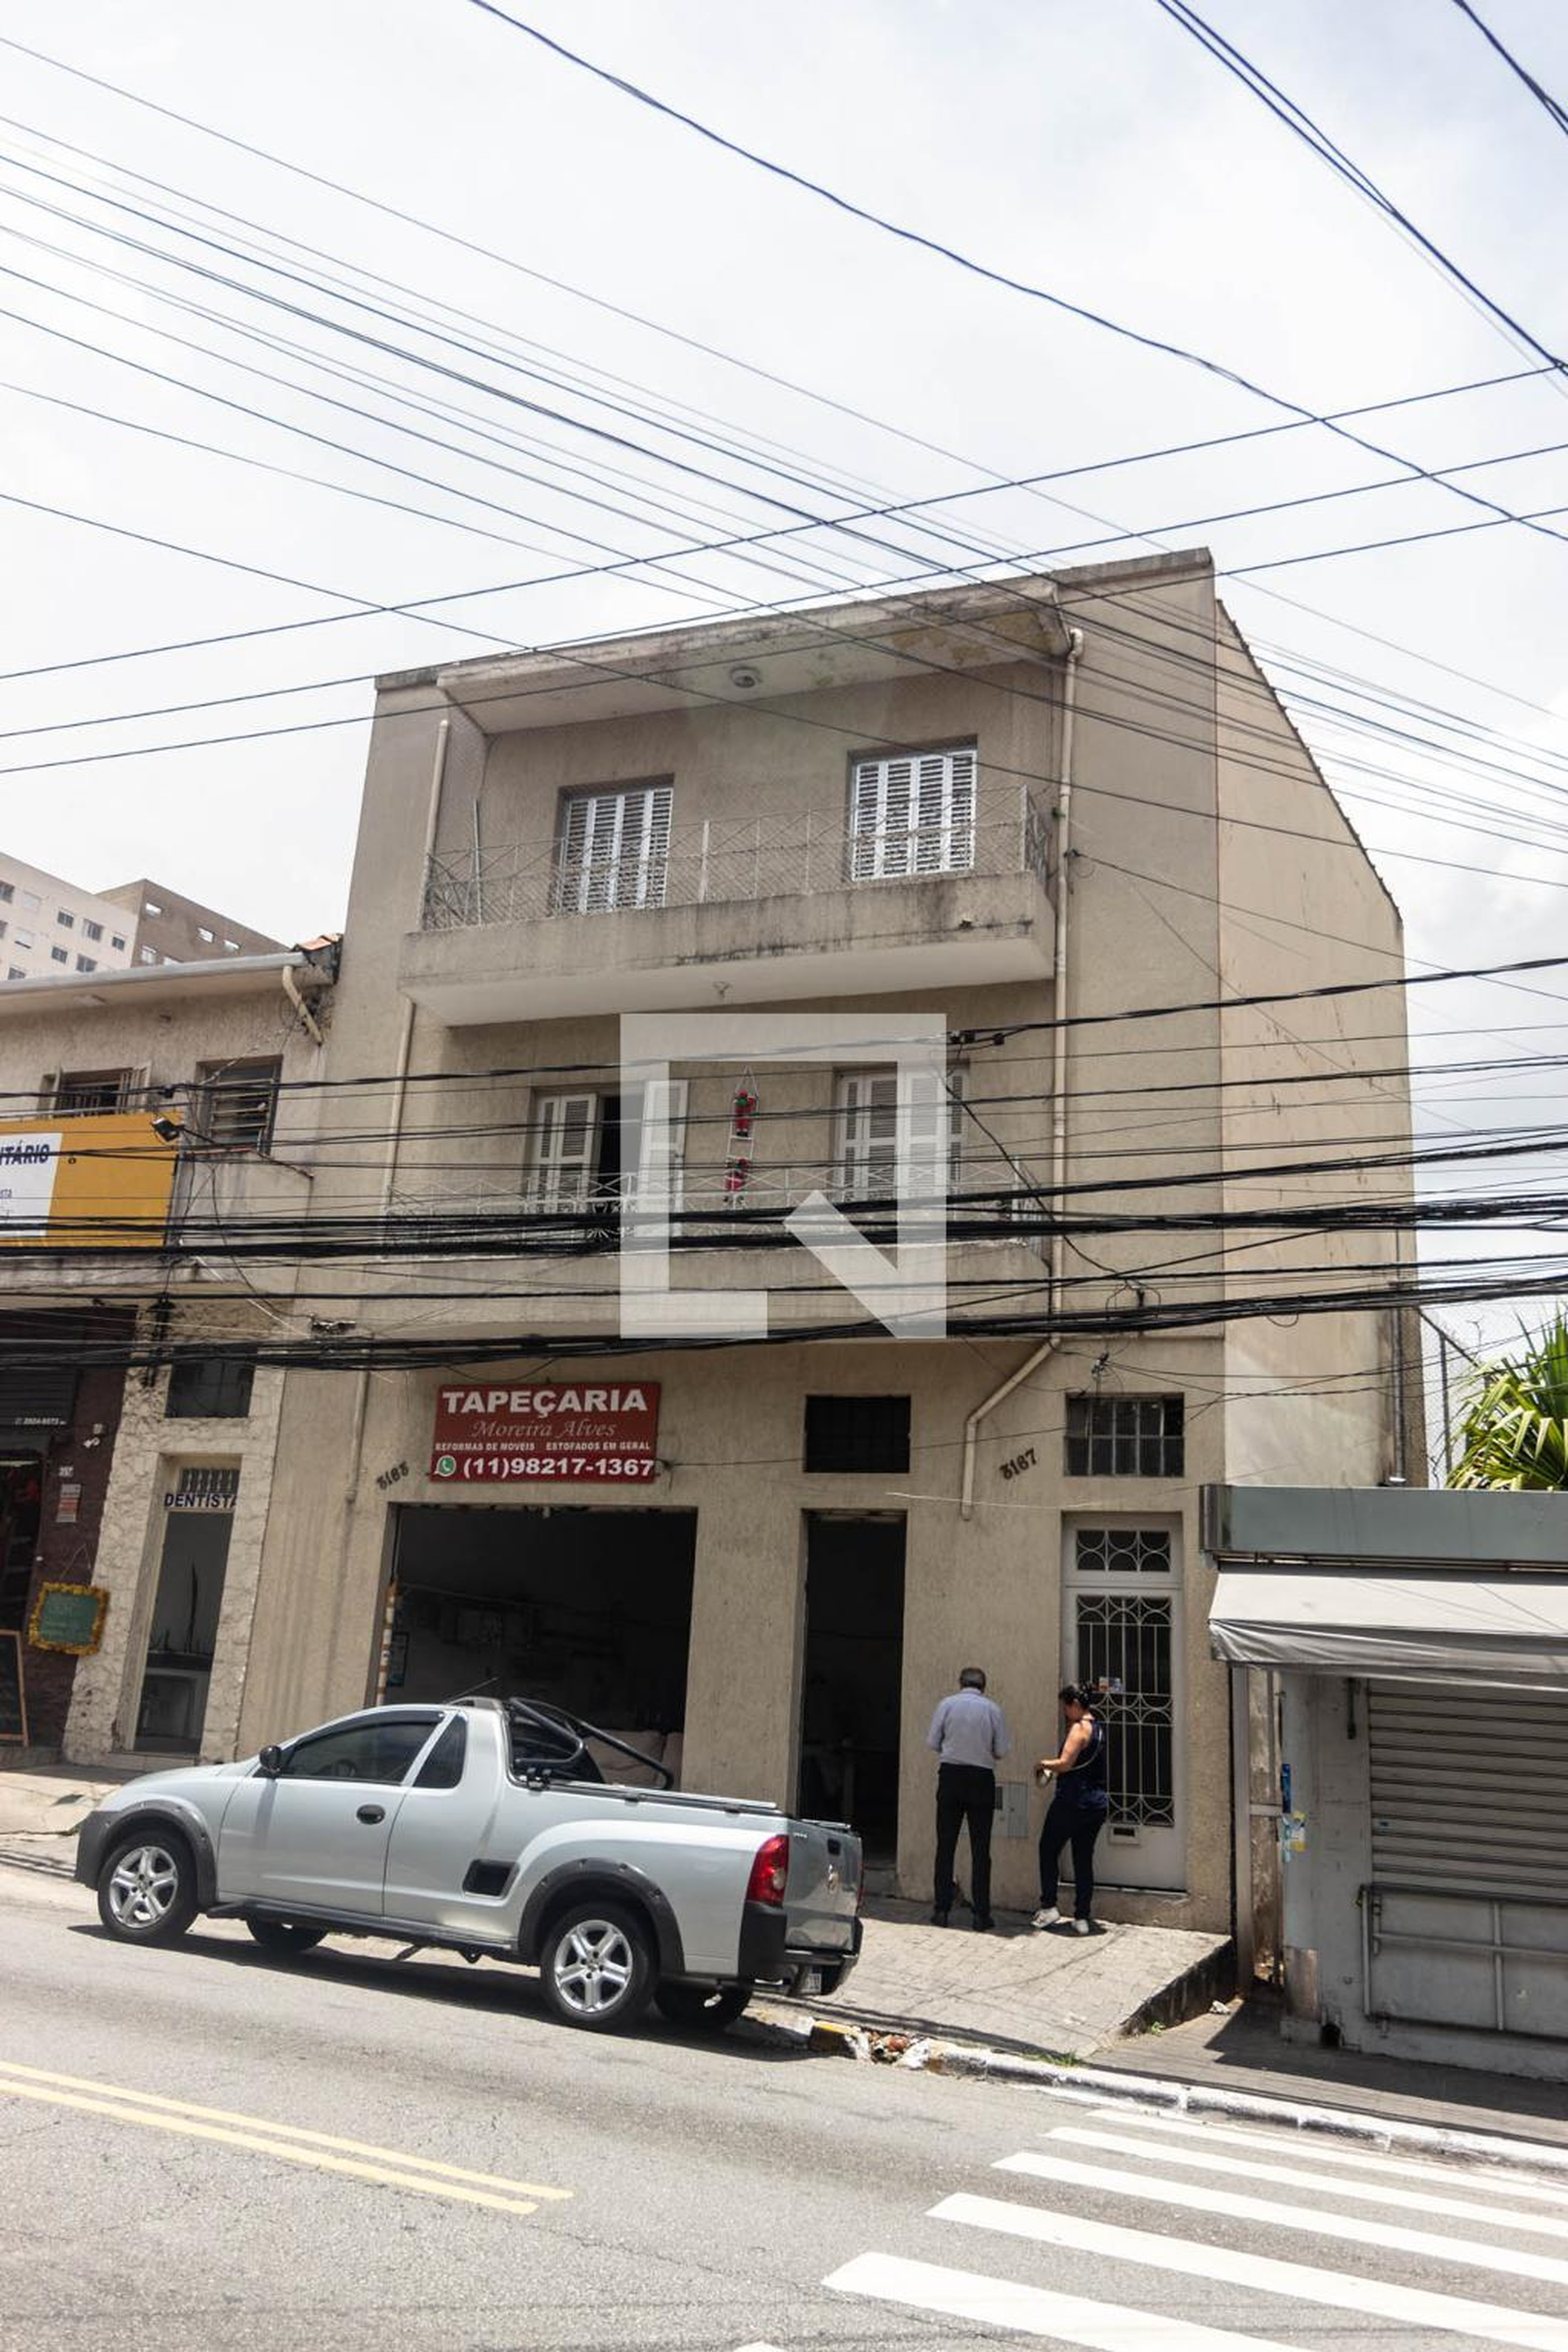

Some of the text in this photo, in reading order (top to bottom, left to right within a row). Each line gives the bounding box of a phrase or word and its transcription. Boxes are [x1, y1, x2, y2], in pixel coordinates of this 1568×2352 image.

[442, 1390, 648, 1418] TAPEÇARIA
[471, 1419, 616, 1438] Moreira Alves
[546, 1442, 600, 1450] ESTOFADOS
[620, 1442, 650, 1450] GERAL
[463, 1457, 654, 1478] (11)98217-1367
